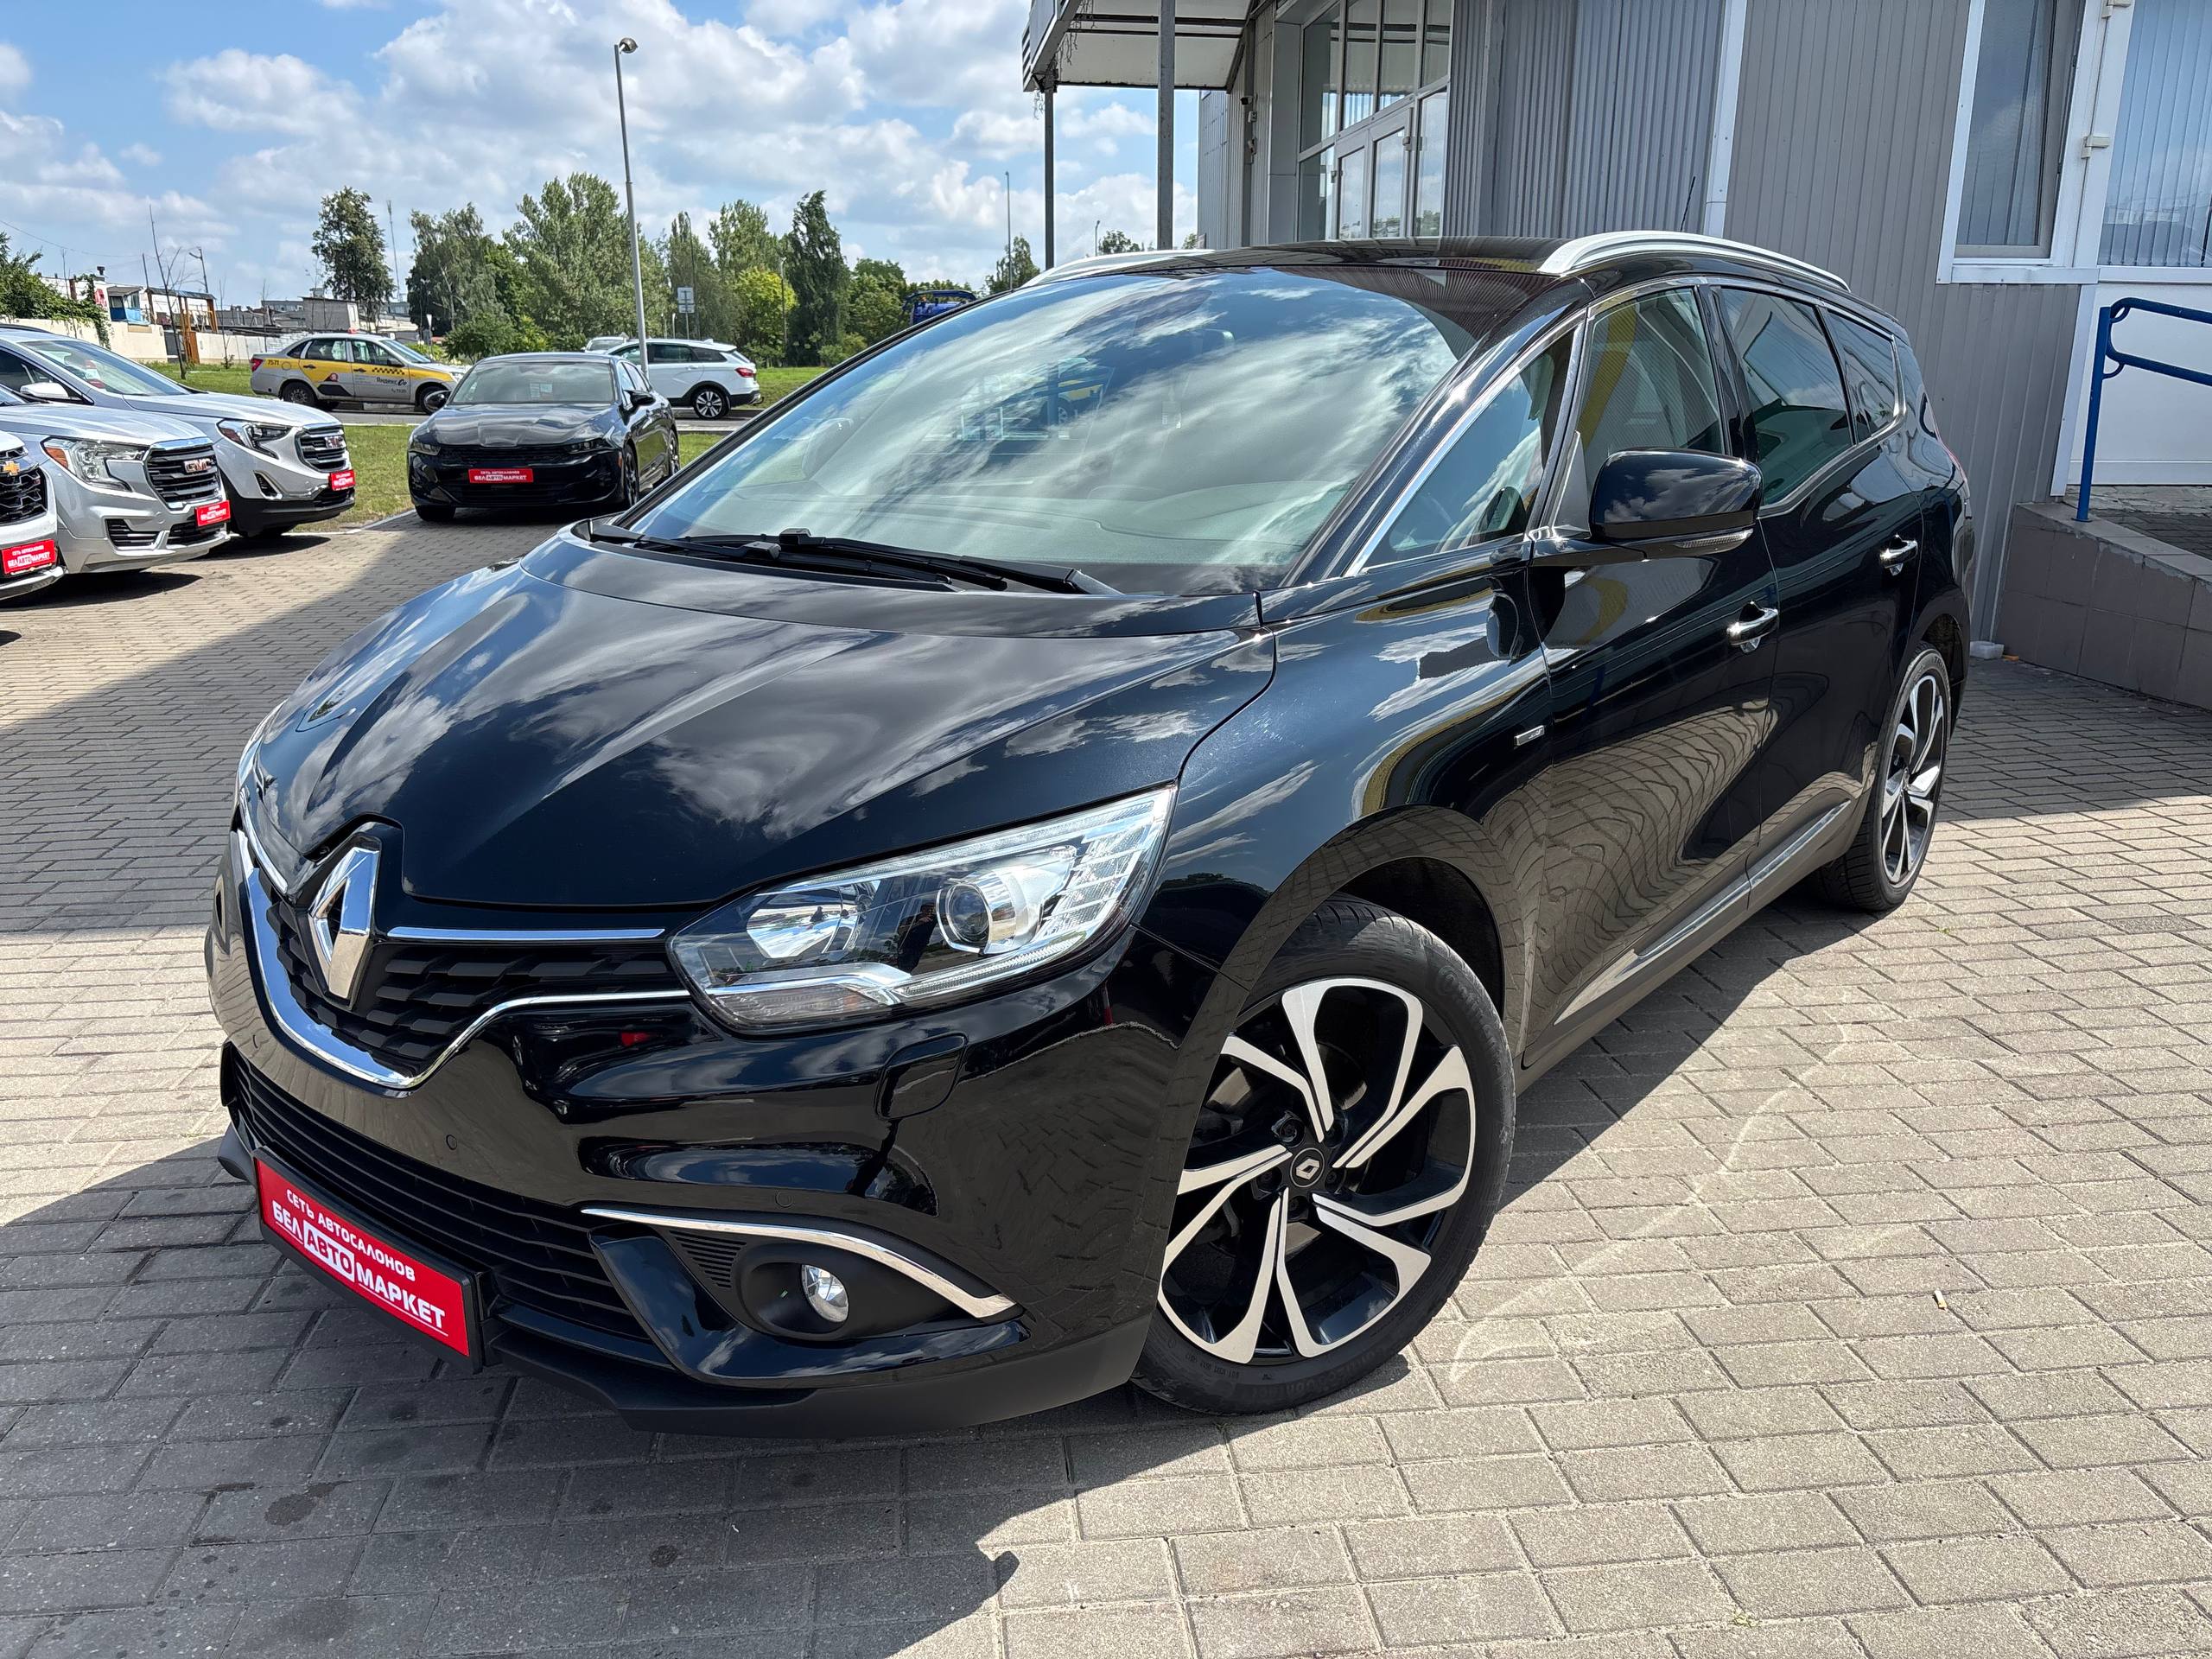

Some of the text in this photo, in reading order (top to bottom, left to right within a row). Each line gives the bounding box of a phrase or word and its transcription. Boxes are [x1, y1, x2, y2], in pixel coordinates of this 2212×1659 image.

[184, 458, 213, 474] GMC
[286, 1189, 416, 1282] СЕТЬ АВТОСАЛОНОВ
